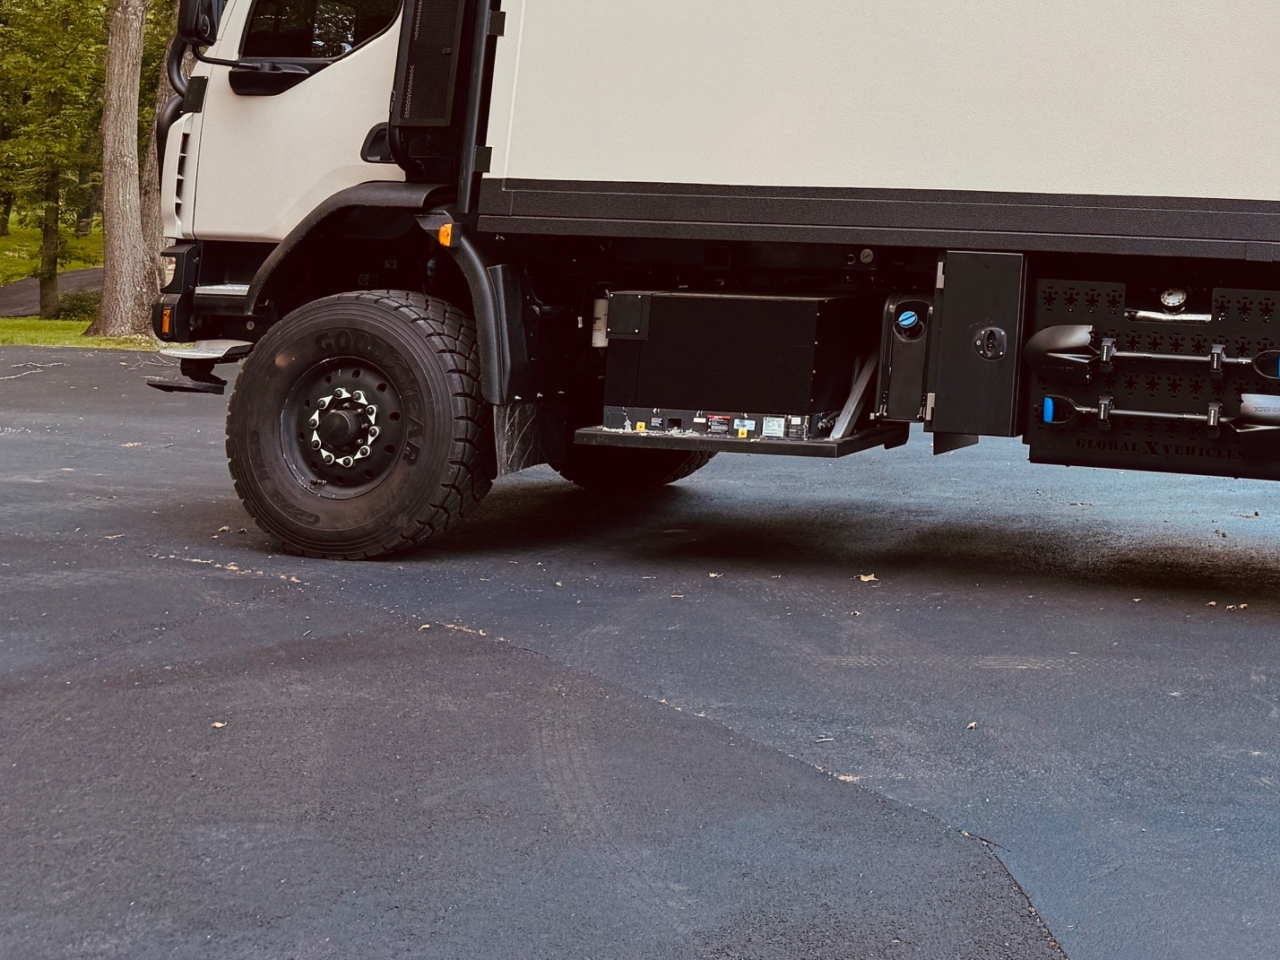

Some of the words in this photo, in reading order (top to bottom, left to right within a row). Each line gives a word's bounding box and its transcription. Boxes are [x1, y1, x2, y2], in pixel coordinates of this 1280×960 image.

[1076, 438, 1140, 453] GLOBAL
[1143, 440, 1160, 456] X
[1162, 444, 1247, 460] VEHICLES
